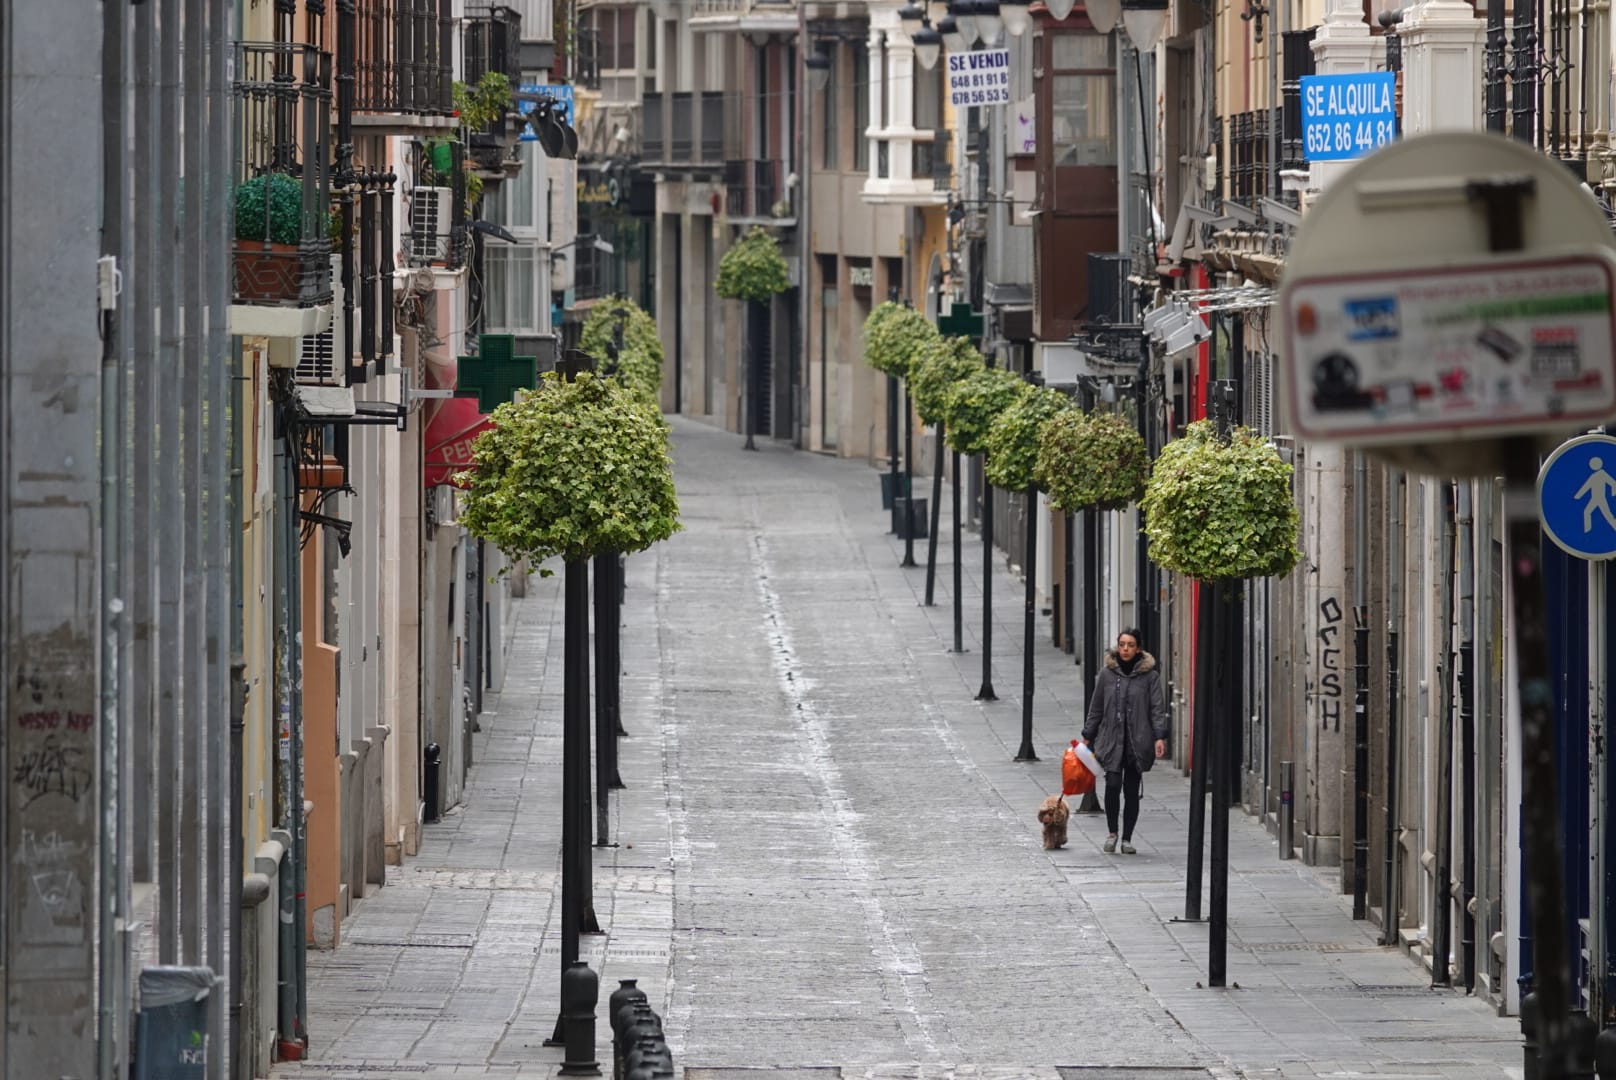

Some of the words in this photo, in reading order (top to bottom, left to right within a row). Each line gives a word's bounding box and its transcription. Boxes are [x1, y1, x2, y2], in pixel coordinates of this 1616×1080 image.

[950, 55, 966, 71] SE
[951, 74, 970, 88] 648
[972, 74, 984, 87] 81
[986, 73, 998, 86] 91
[952, 91, 970, 105] 678
[972, 90, 985, 103] 56
[987, 89, 999, 102] 53
[1306, 85, 1325, 117] SE
[1328, 82, 1392, 117] ALQUILA
[1307, 123, 1332, 152] 652
[1335, 122, 1352, 151] 86
[1355, 120, 1373, 150] 44
[1377, 120, 1393, 149] 81
